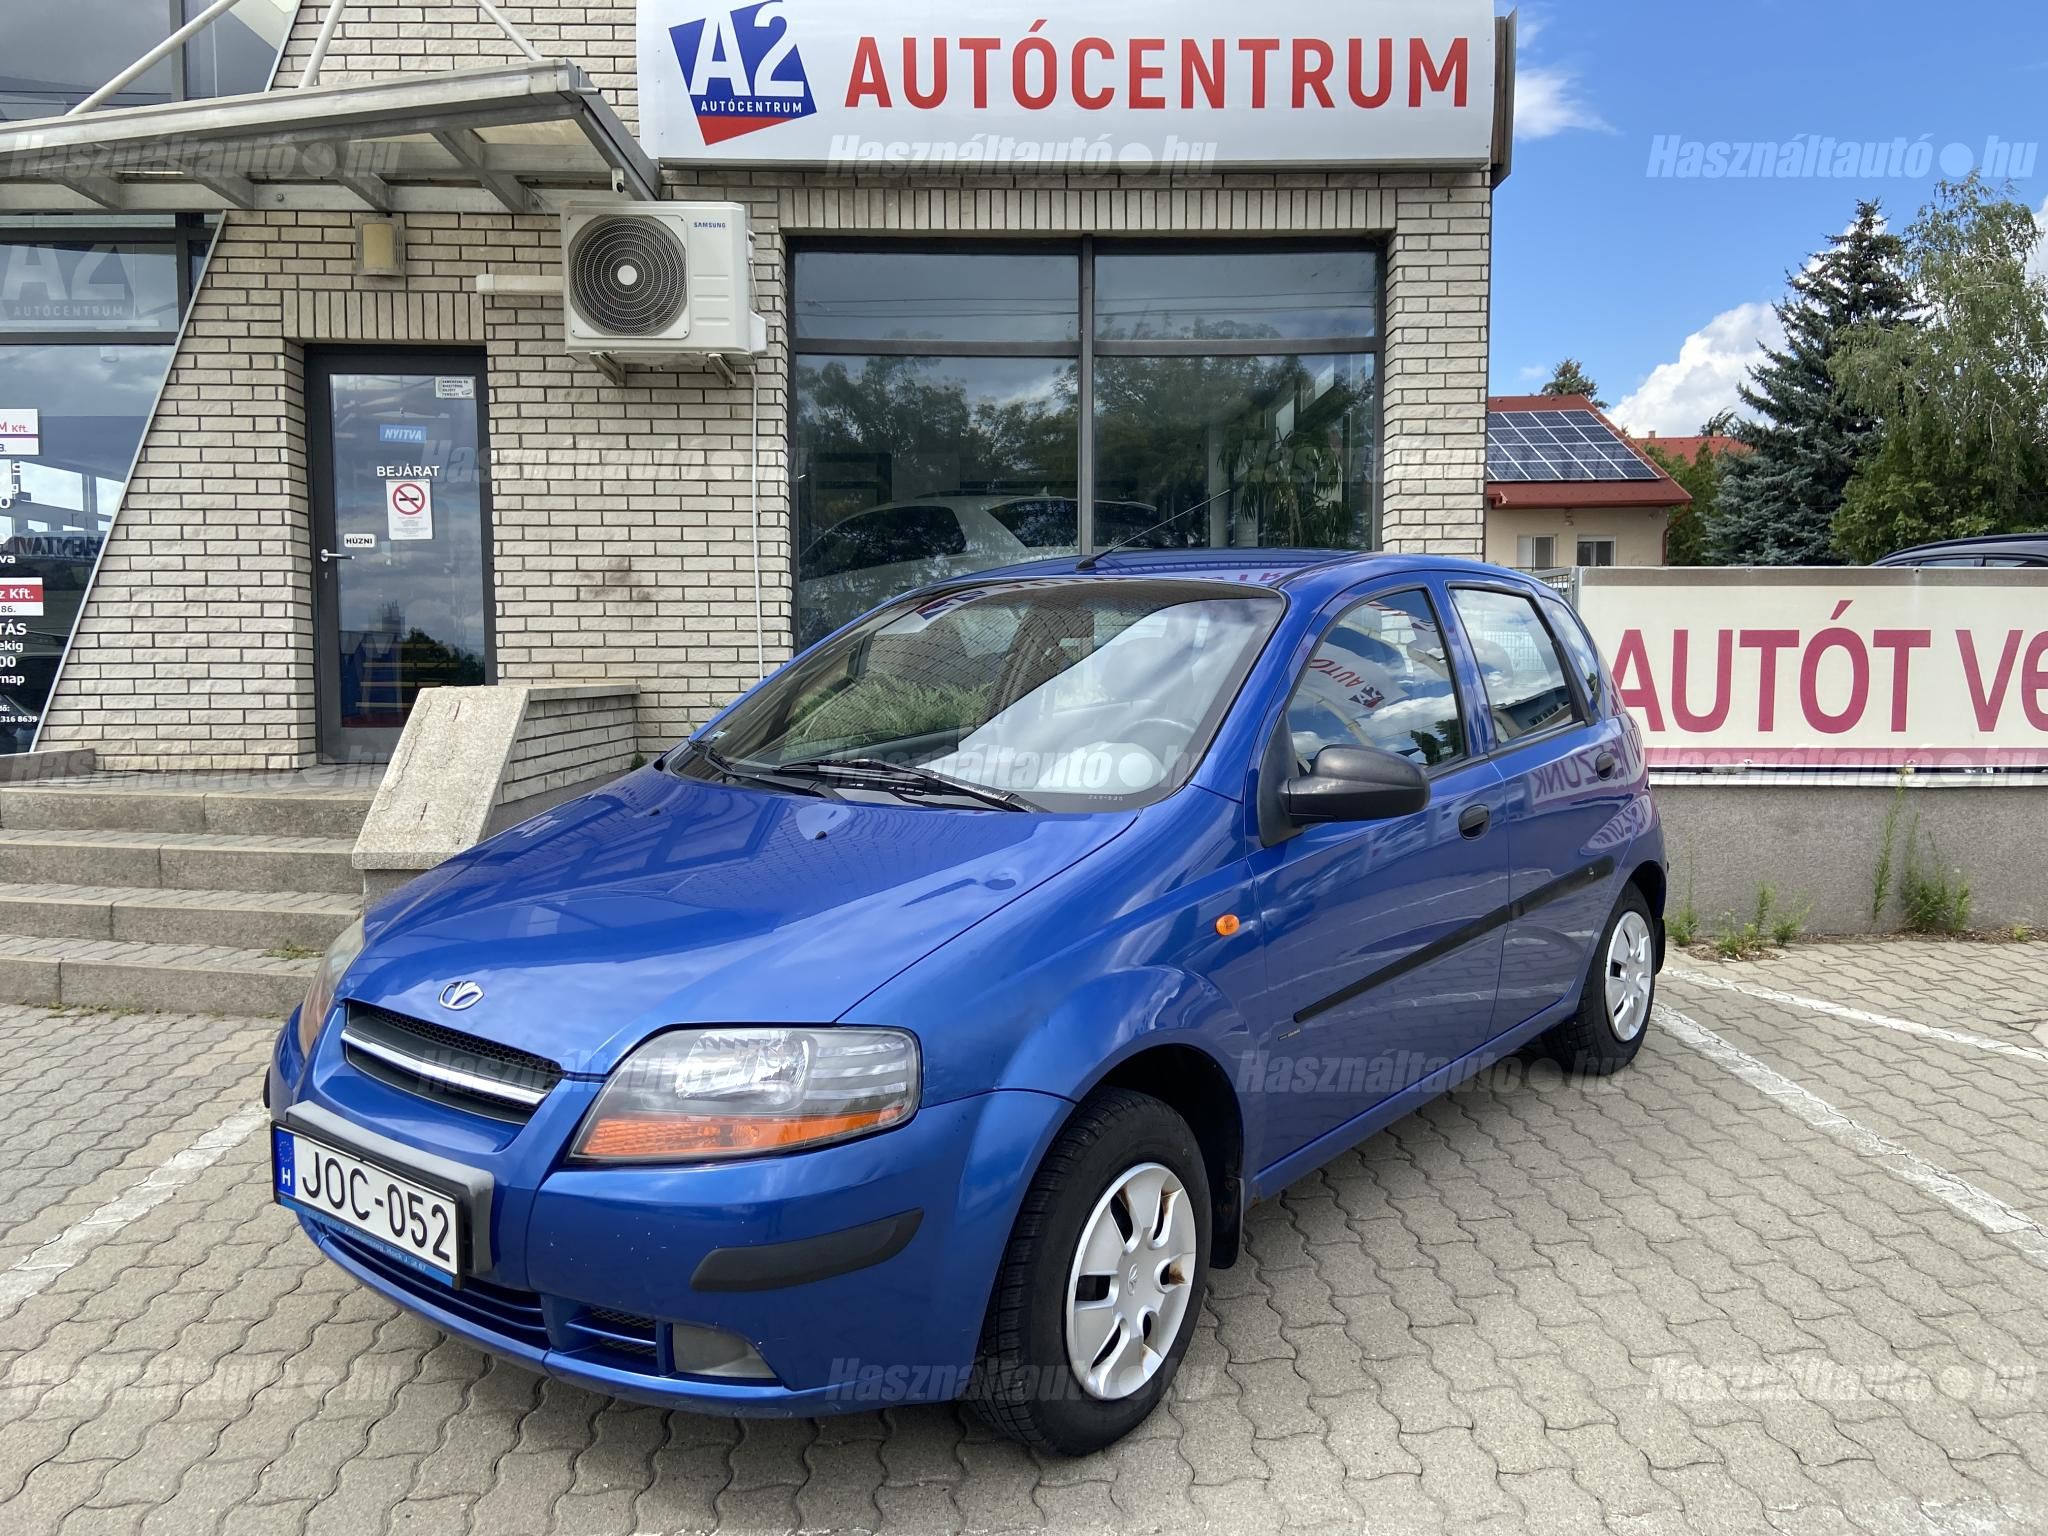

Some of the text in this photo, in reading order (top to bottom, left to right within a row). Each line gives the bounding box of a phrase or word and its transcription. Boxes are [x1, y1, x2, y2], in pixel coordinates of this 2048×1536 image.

[689, 1, 805, 97] A2
[845, 19, 1468, 110] AUTÓCENTRUM
[700, 99, 802, 113] AUTÓCENTRUM
[693, 221, 726, 229] SAMSUNG
[384, 428, 422, 441] NYITVA
[376, 463, 440, 477] BEJÁRAT
[9, 588, 35, 600] Kft.
[1611, 600, 1932, 734] AUTÓT
[281, 1167, 291, 1187] H
[302, 1151, 450, 1263] JOC-052
